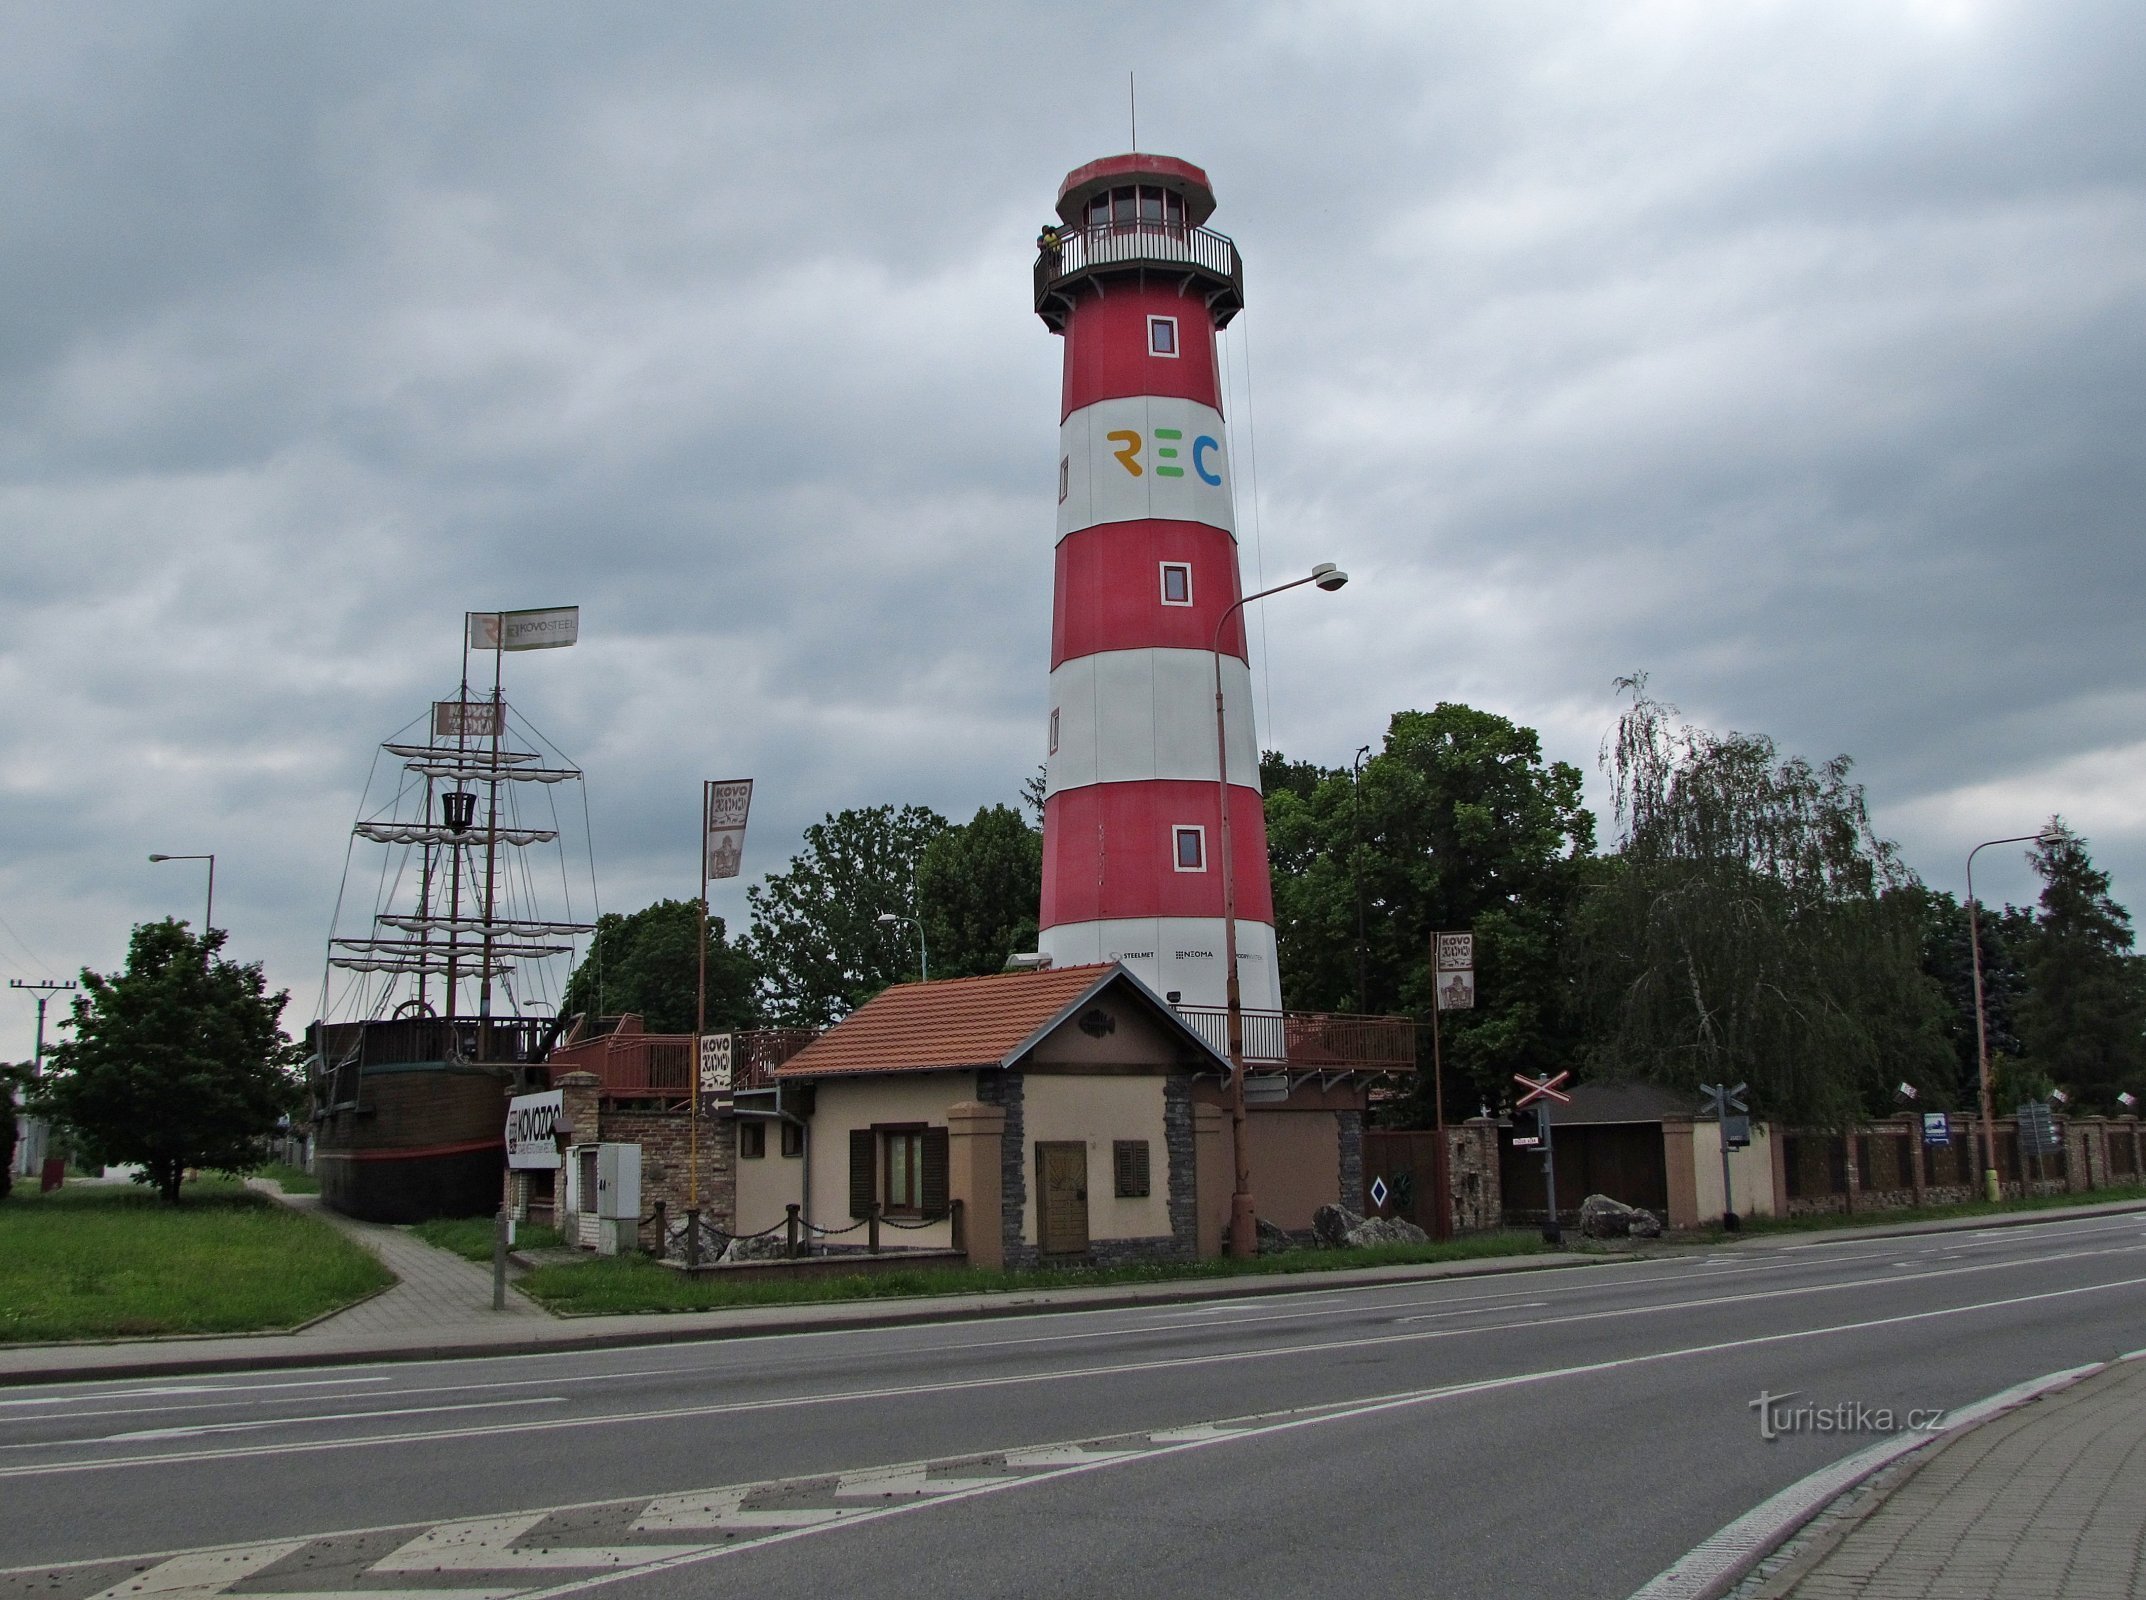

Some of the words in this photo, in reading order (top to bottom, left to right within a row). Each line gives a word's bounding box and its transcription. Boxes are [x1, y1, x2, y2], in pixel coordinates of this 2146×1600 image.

[1106, 427, 1222, 487] REC
[520, 619, 576, 633] KOVOSTEEL
[716, 785, 748, 798] KOVO
[1442, 936, 1471, 946] KOVO
[1123, 951, 1155, 959] STEELMET
[702, 1037, 730, 1053] KOVO
